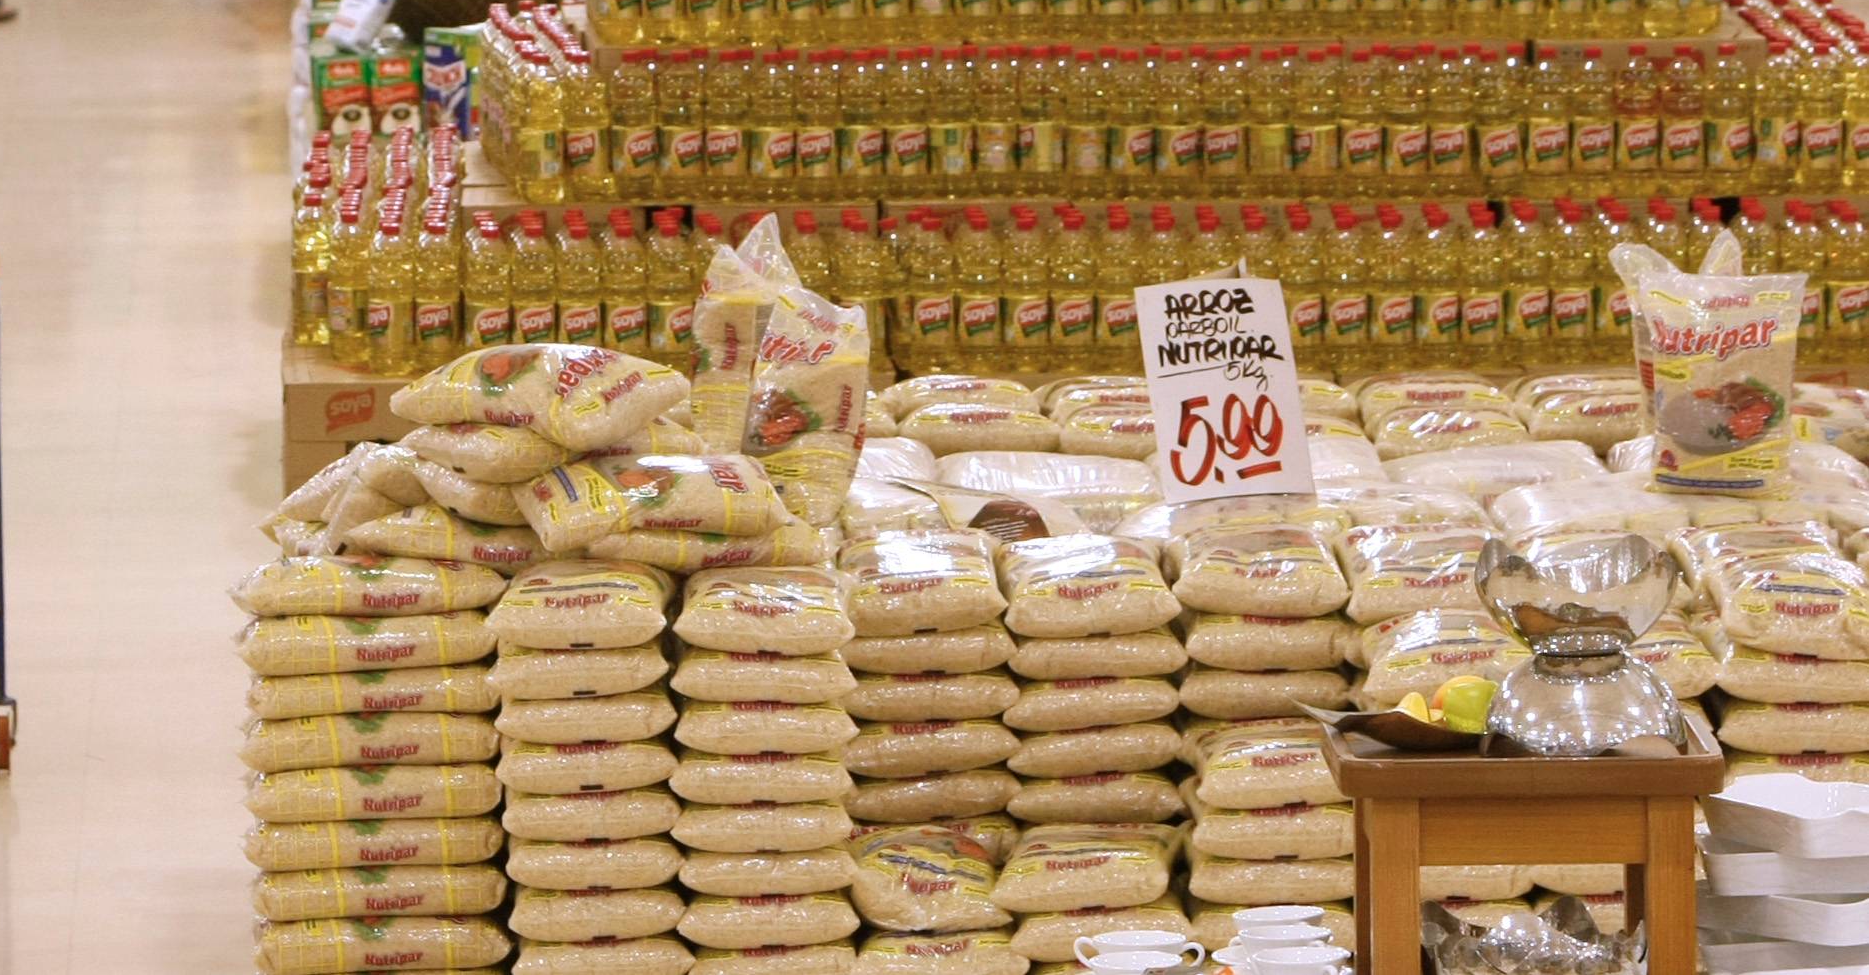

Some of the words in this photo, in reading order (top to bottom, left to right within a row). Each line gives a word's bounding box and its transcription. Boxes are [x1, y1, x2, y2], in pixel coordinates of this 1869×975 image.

[1164, 288, 1255, 320] ARROZ
[1157, 334, 1285, 368] NUTRIPAR
[1170, 392, 1284, 487] 5.99
[472, 546, 532, 564] Nutripar
[362, 593, 420, 610] Nutripar
[1774, 600, 1840, 616] Nutripar
[356, 644, 415, 662] Nutripar
[363, 694, 422, 710] Nutripar
[359, 743, 420, 761] Nutripar
[363, 793, 422, 813] Nutripar
[359, 844, 419, 863] Nutripar
[365, 894, 423, 911] Nutripar
[364, 952, 423, 967] Nutripar
